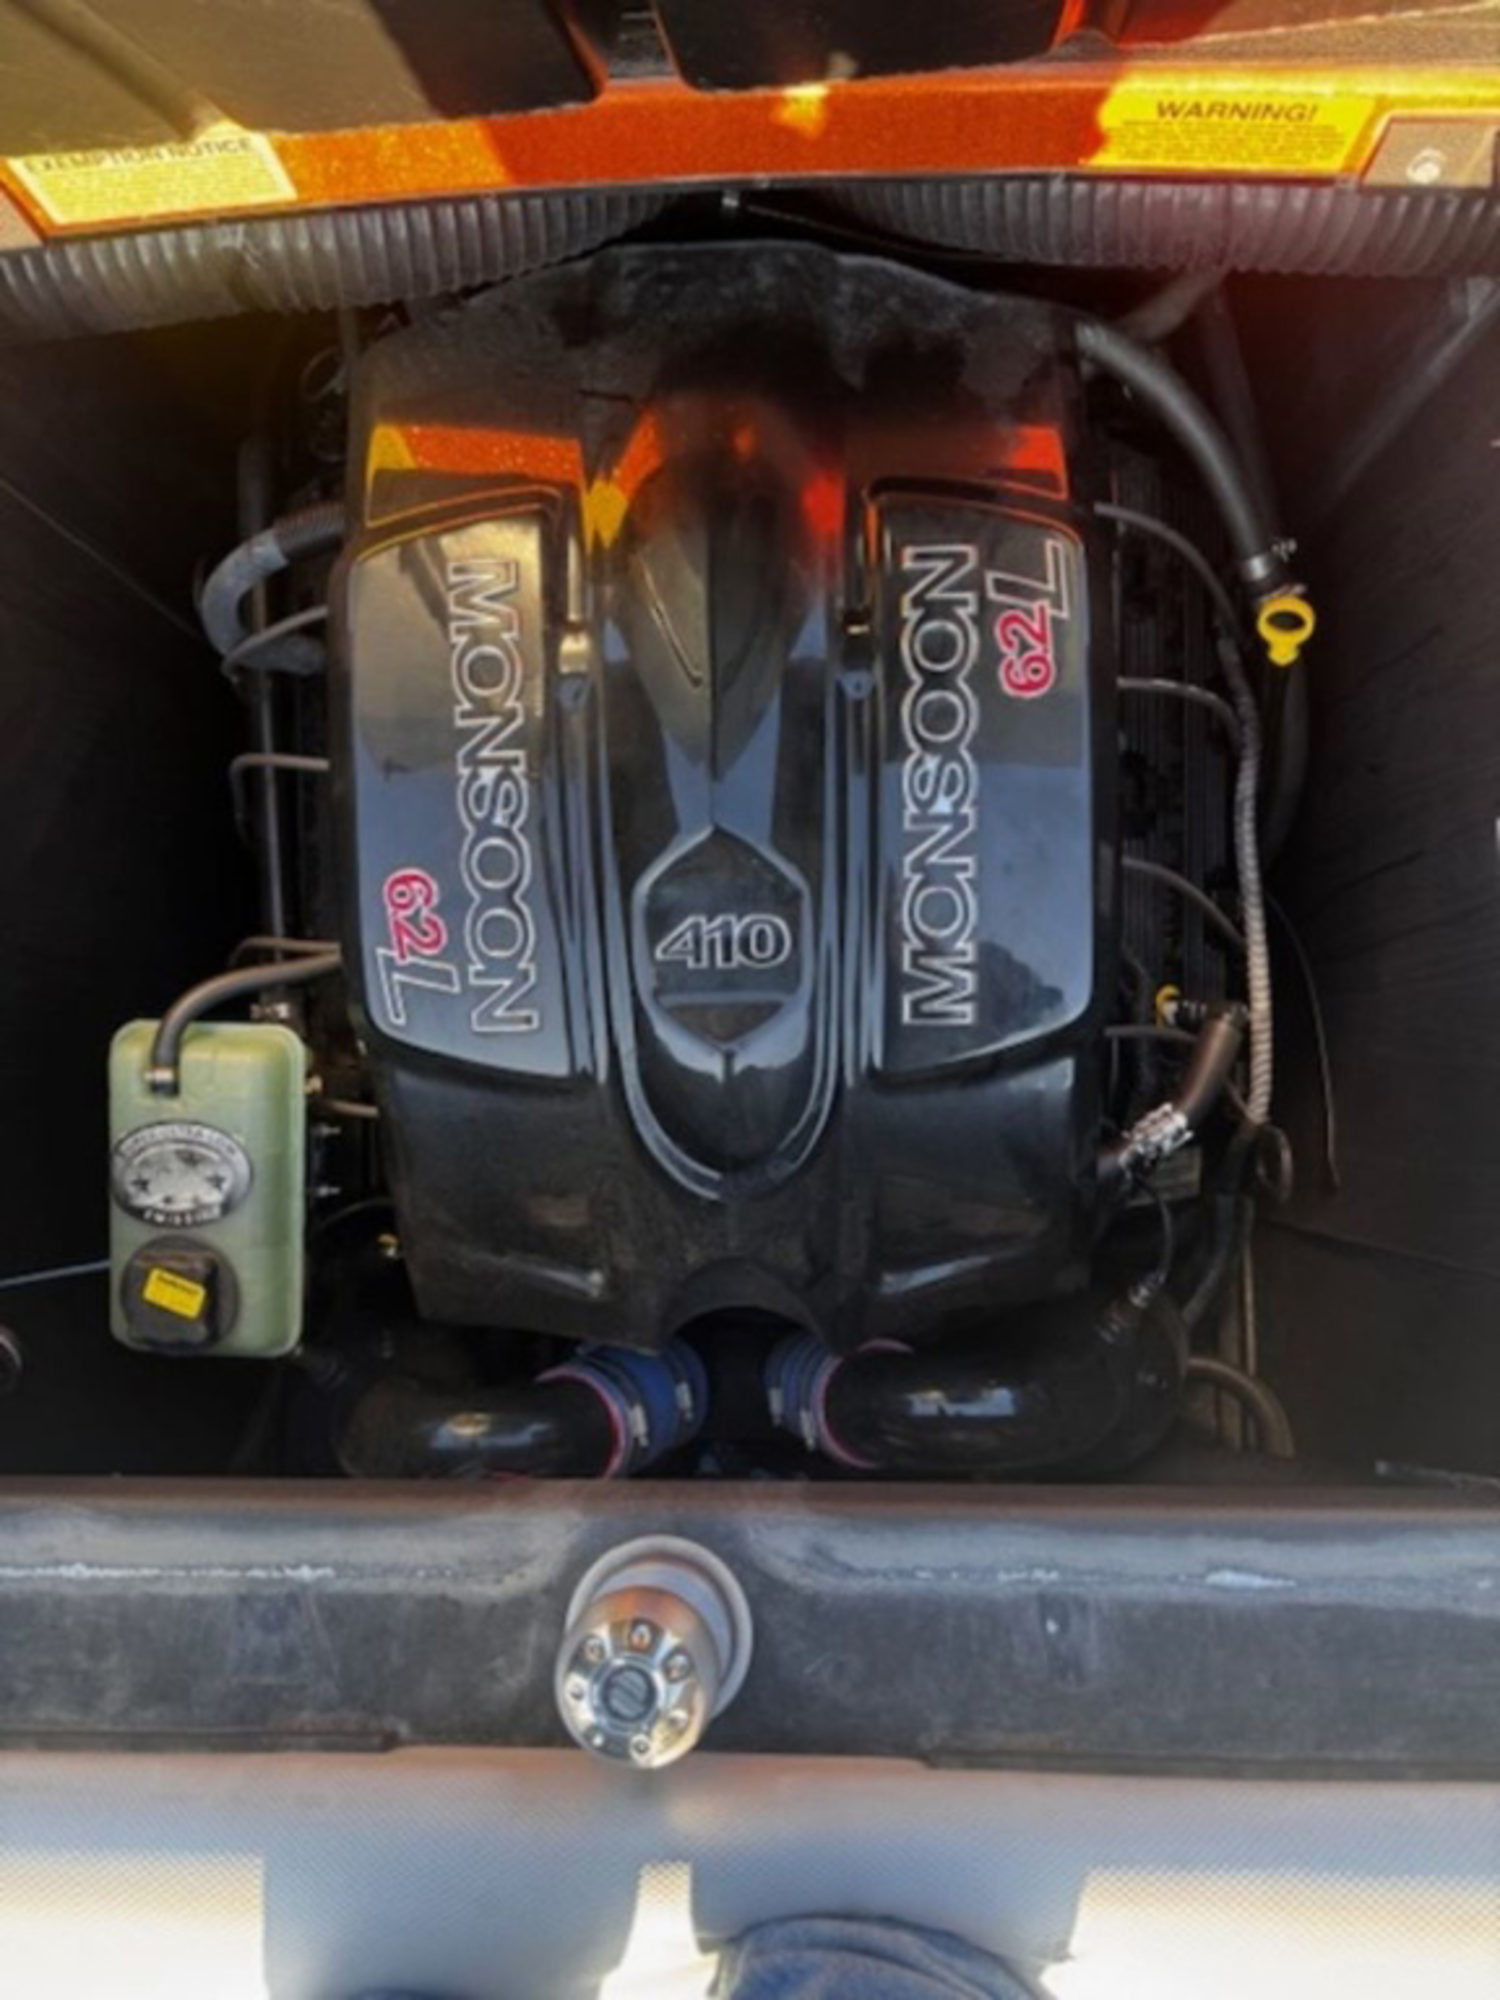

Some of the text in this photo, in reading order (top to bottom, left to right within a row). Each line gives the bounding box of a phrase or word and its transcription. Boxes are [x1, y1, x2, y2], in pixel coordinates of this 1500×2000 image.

[1156, 99, 1319, 122] WARNING!
[168, 137, 251, 160] NOTICE
[447, 559, 540, 1034] MONSOON
[902, 544, 979, 1026] MONSOON
[655, 912, 792, 970] 410
